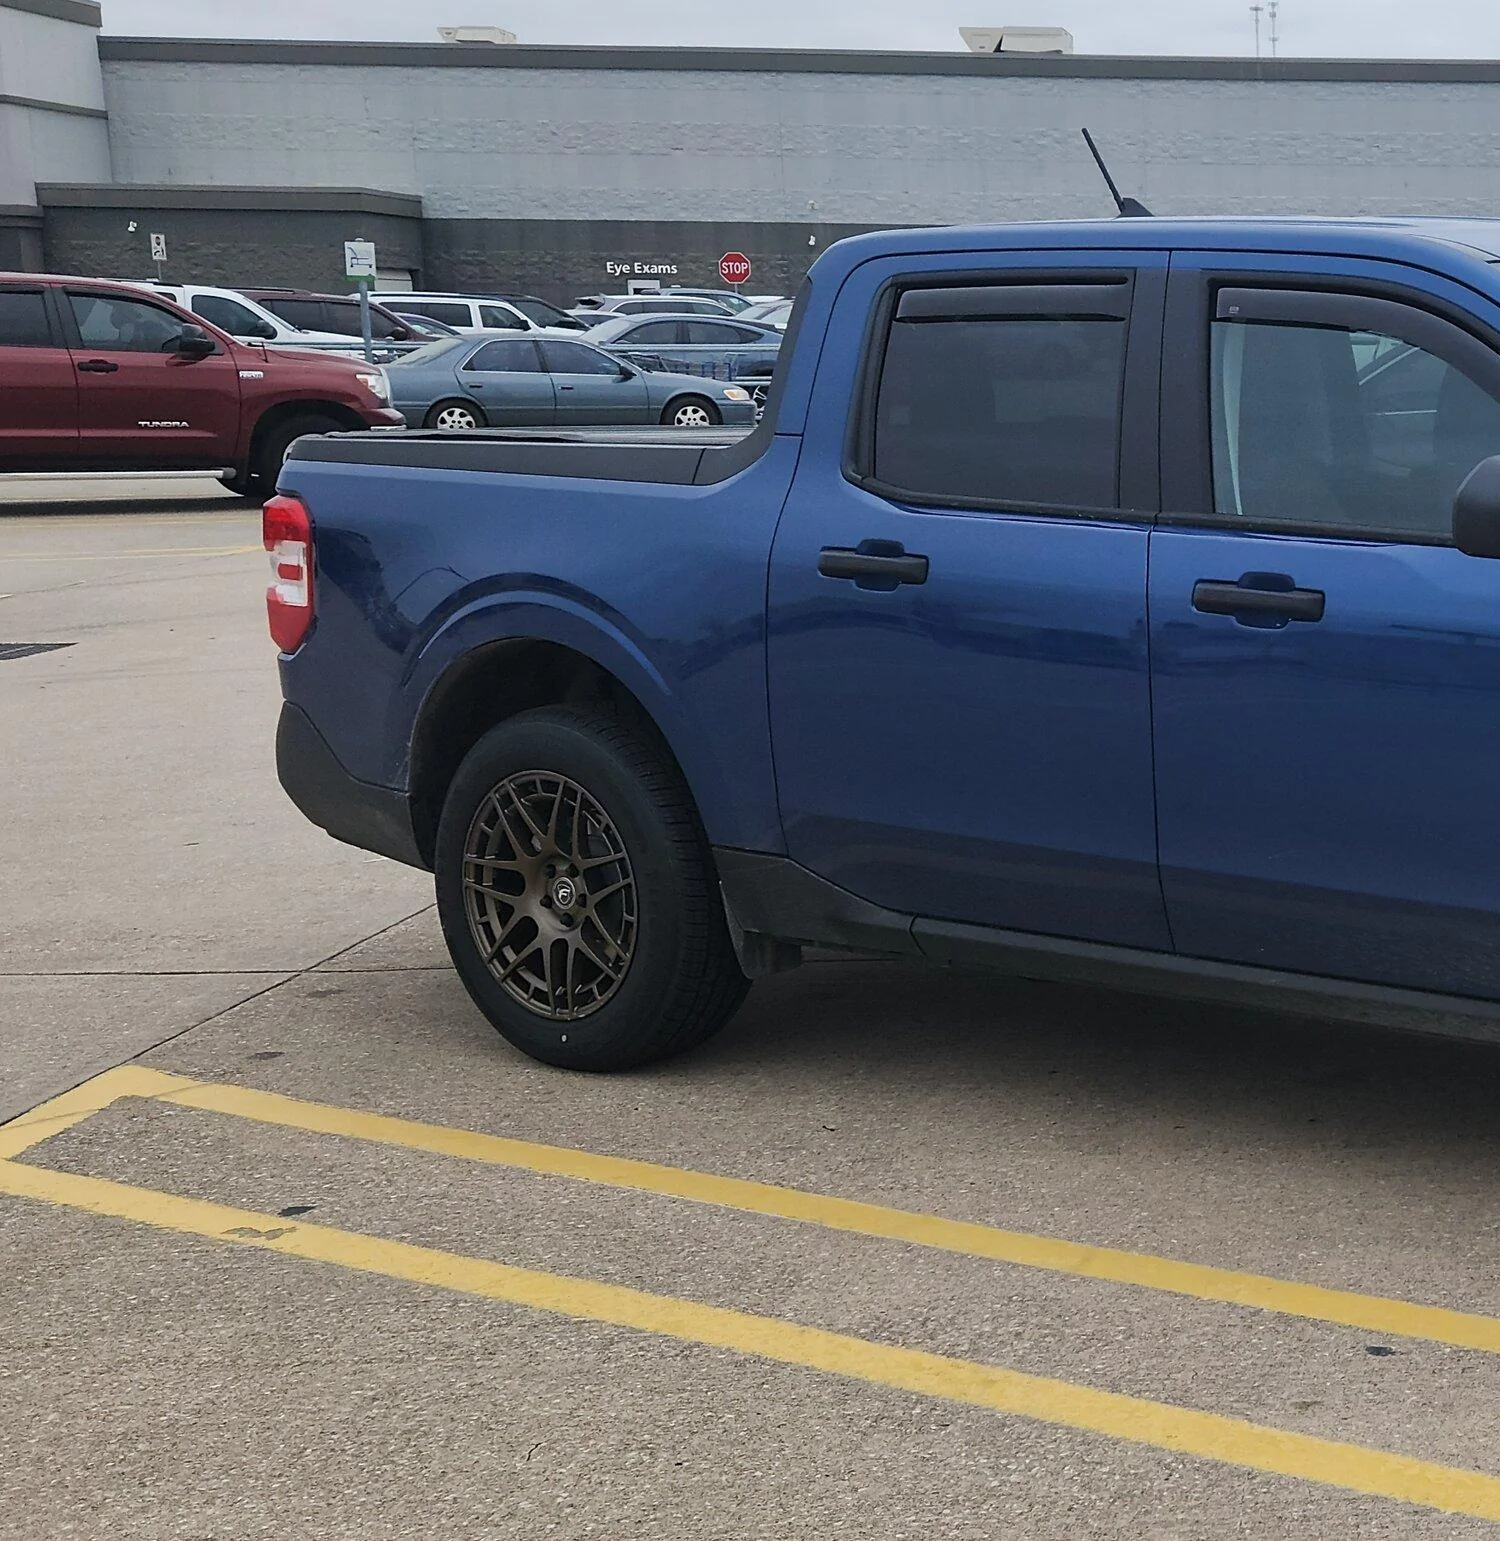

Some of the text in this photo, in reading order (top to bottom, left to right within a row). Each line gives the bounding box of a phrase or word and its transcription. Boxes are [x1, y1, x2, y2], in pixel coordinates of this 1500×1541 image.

[606, 261, 678, 276] Eye Exams
[721, 262, 748, 274] STOP
